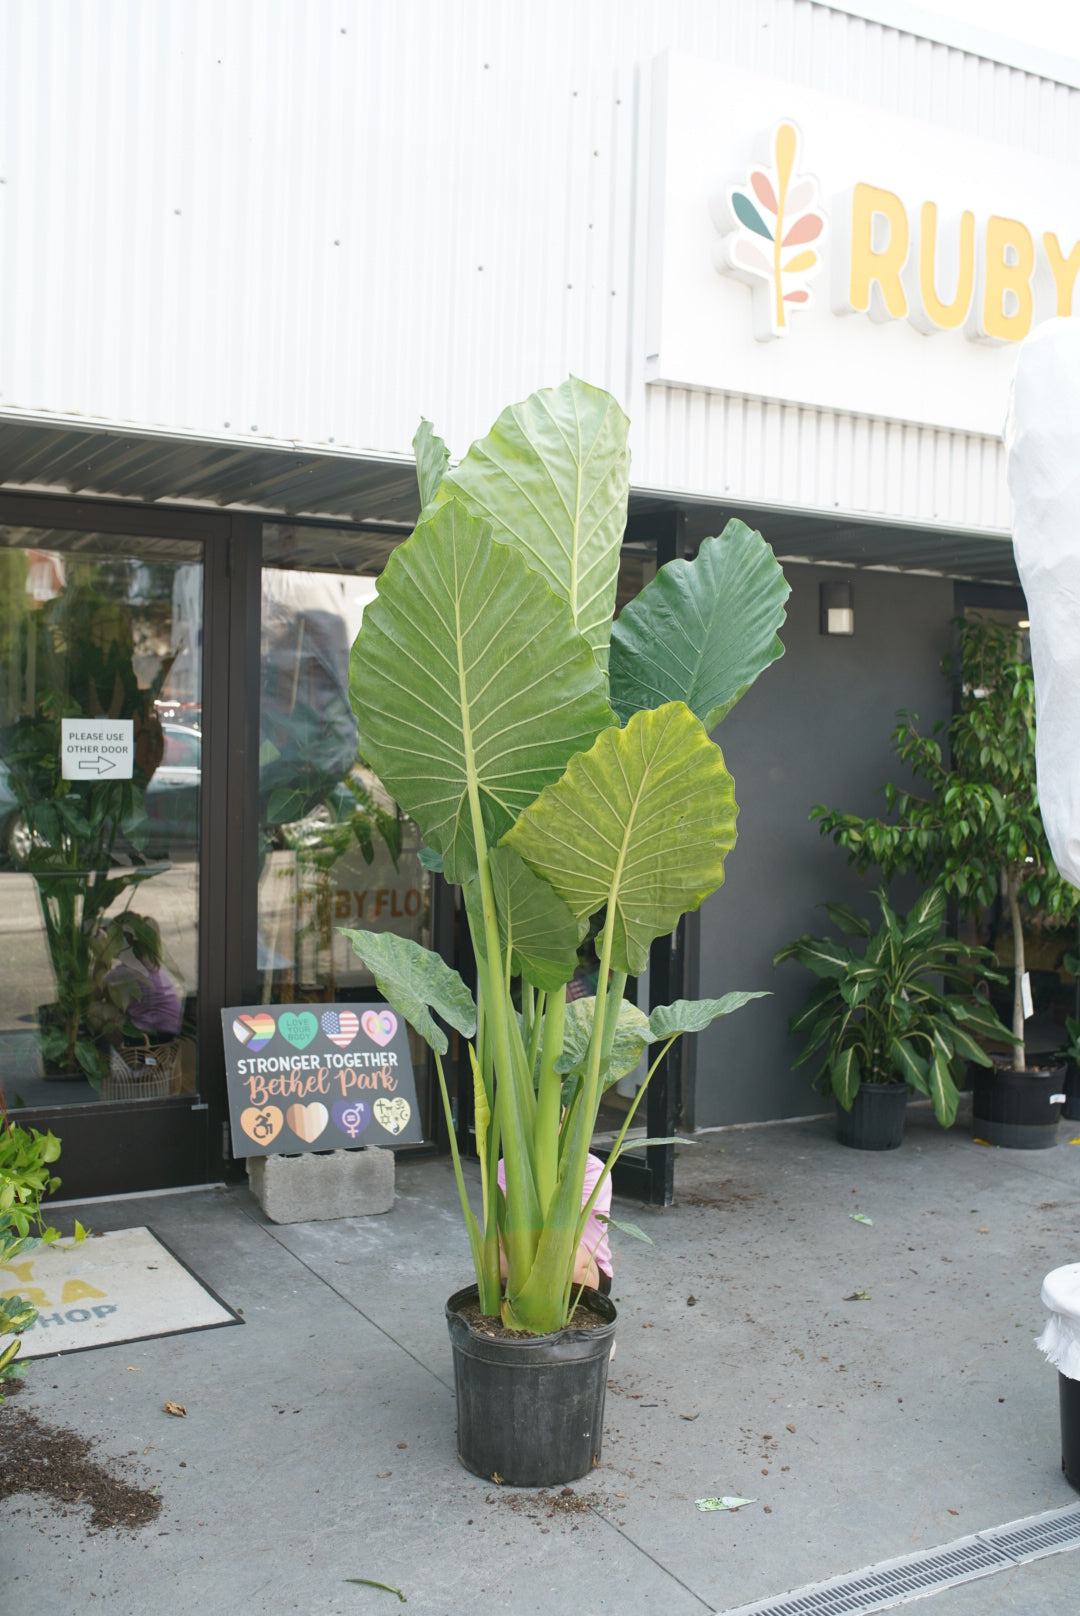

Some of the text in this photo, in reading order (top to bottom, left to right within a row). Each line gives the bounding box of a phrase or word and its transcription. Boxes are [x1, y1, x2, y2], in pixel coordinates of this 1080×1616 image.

[849, 181, 1080, 342] RUBY
[69, 732, 124, 741] PLEASE USE
[67, 745, 99, 753] OTHER
[288, 1033, 311, 1041] BODY
[237, 1052, 398, 1074] STRONGER TOGETHER
[243, 1065, 398, 1106] Bethel Park
[25, 1304, 118, 1332] HOP
